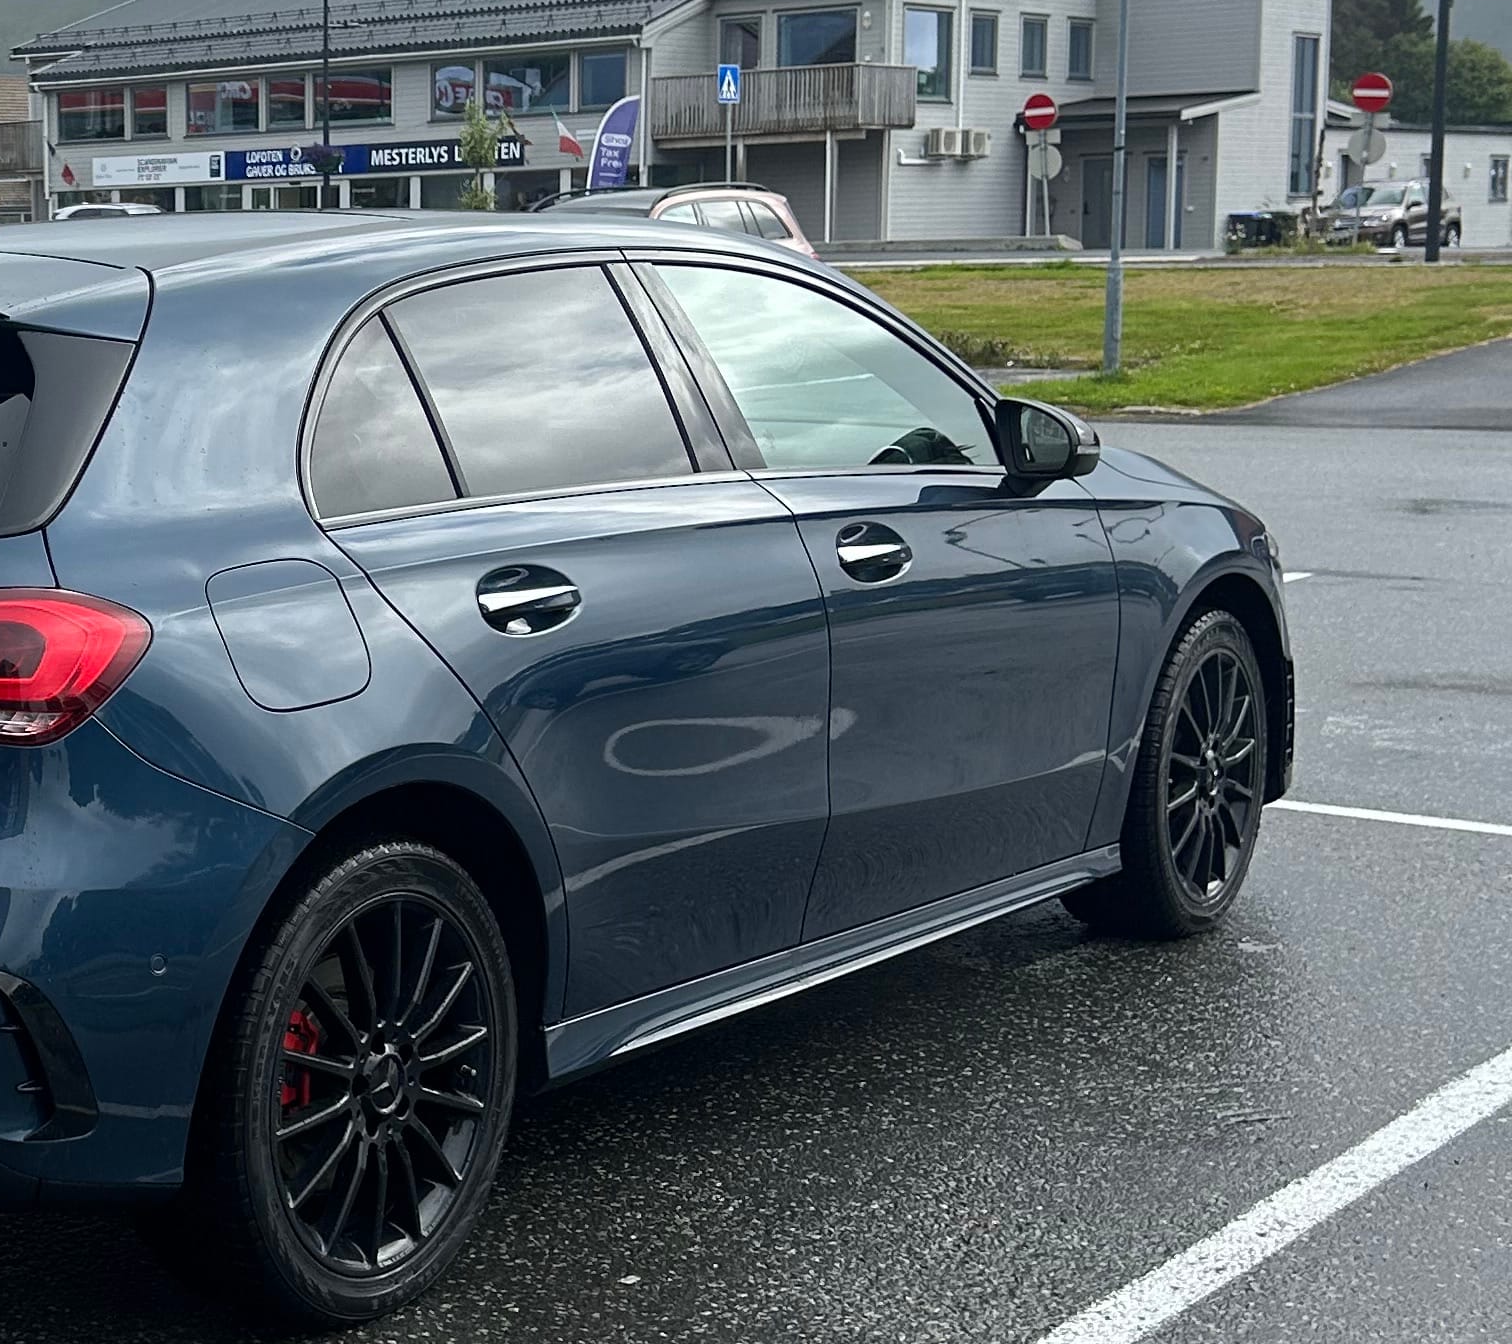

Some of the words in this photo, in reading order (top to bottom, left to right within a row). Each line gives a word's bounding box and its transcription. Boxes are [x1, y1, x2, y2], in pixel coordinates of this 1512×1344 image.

[246, 151, 283, 163] LOFOTEN
[370, 146, 448, 166] MESTERLYS
[454, 142, 521, 162] LTEN
[600, 147, 619, 157] Tax
[246, 166, 273, 177] GAVER
[275, 165, 287, 176] OG
